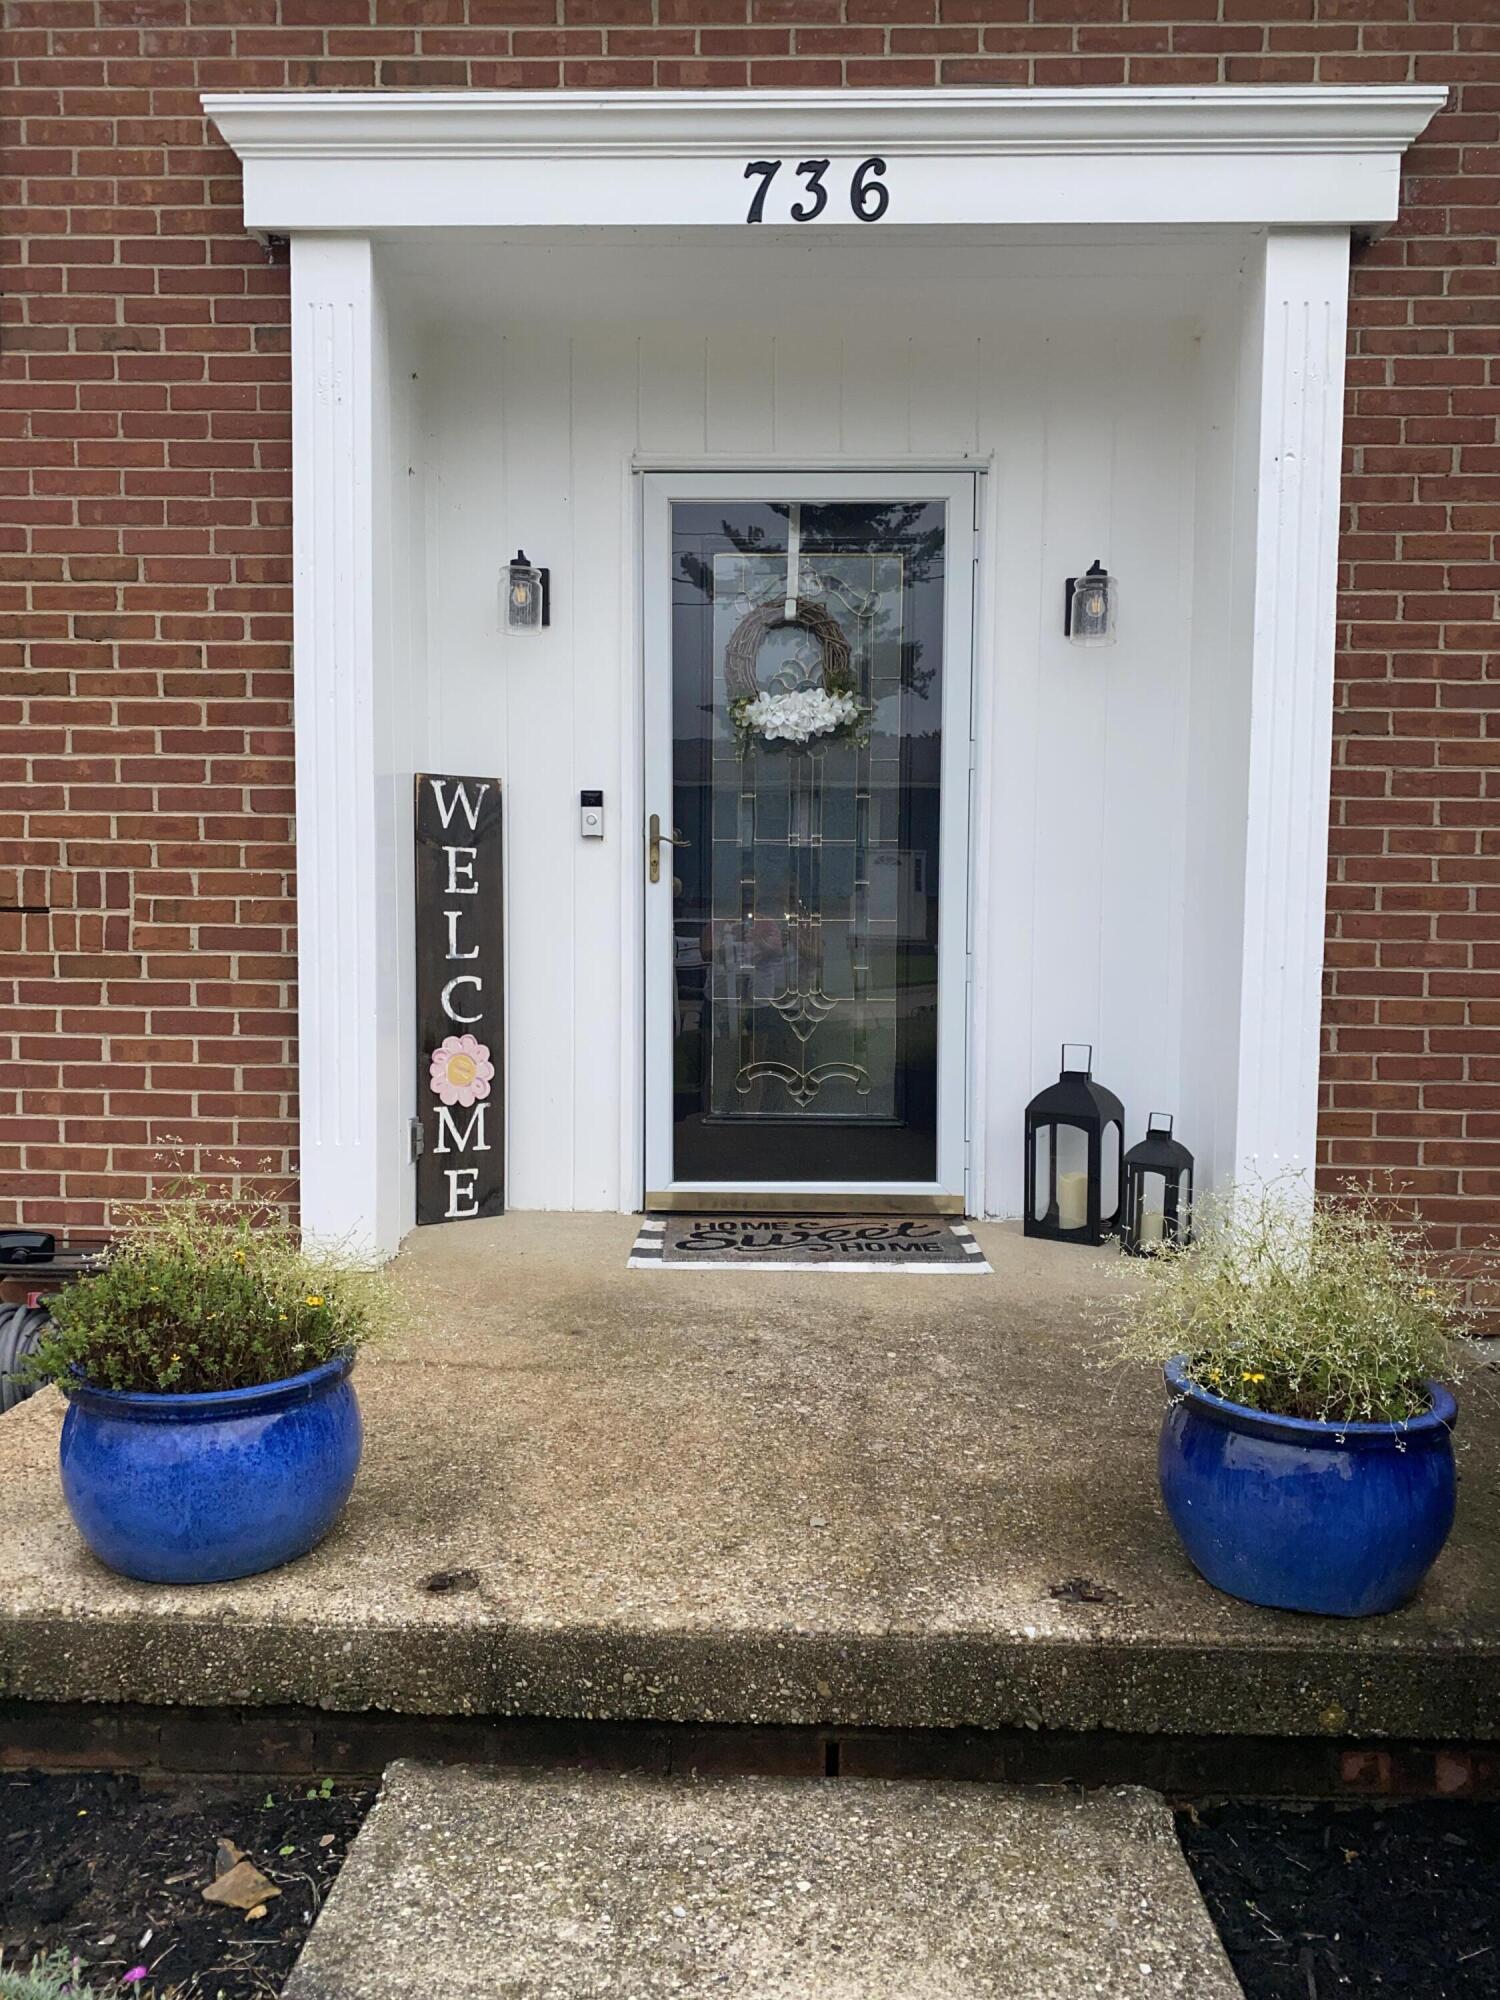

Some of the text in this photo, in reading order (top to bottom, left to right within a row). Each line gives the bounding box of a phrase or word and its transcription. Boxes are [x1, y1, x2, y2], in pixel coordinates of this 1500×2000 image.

[743, 157, 890, 224] 736
[674, 1221, 942, 1252] Sweet
[694, 1221, 791, 1232] HOME
[840, 1241, 945, 1254] HOME
